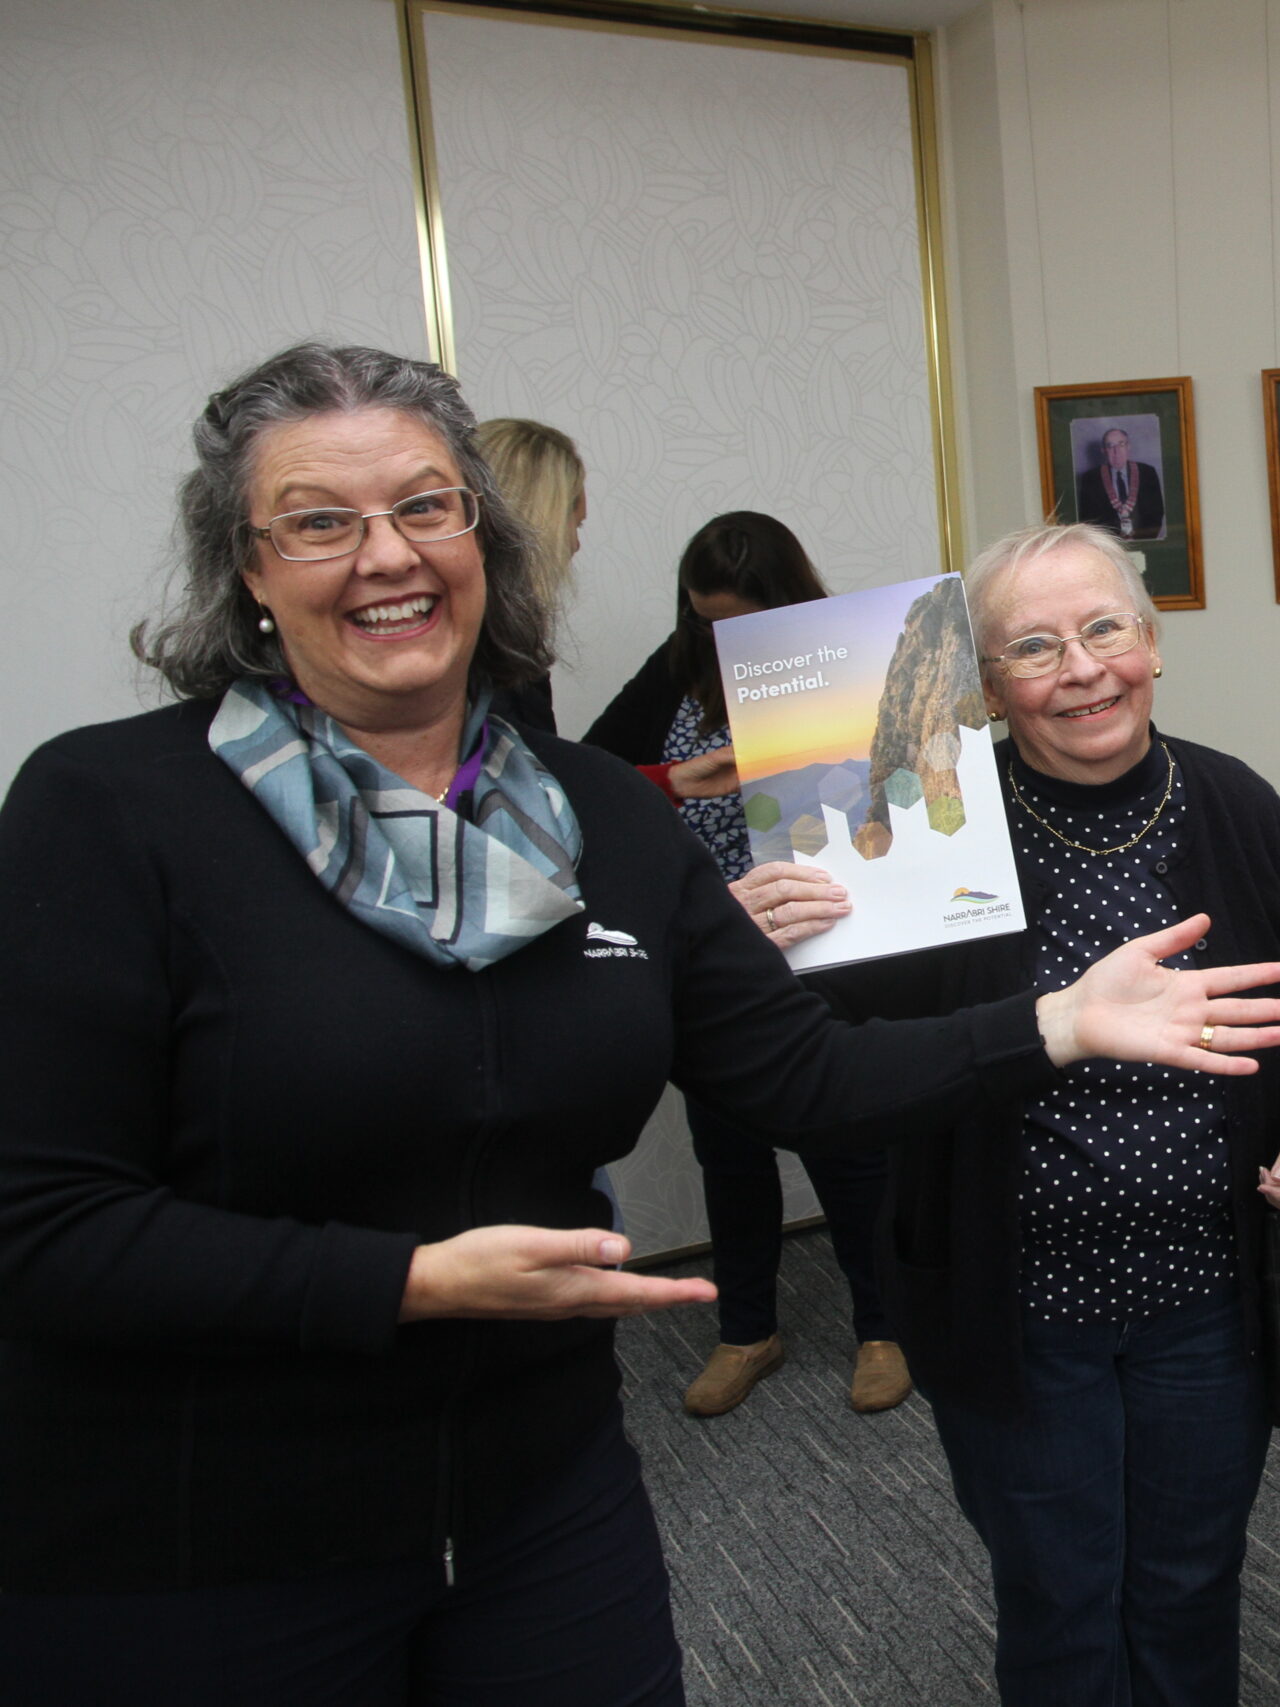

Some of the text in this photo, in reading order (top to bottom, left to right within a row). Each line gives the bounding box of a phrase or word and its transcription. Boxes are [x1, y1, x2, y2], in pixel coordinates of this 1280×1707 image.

[733, 645, 848, 680] Discover the
[737, 671, 830, 704] Potential.
[943, 903, 1011, 922] NARRABRI SHIRE
